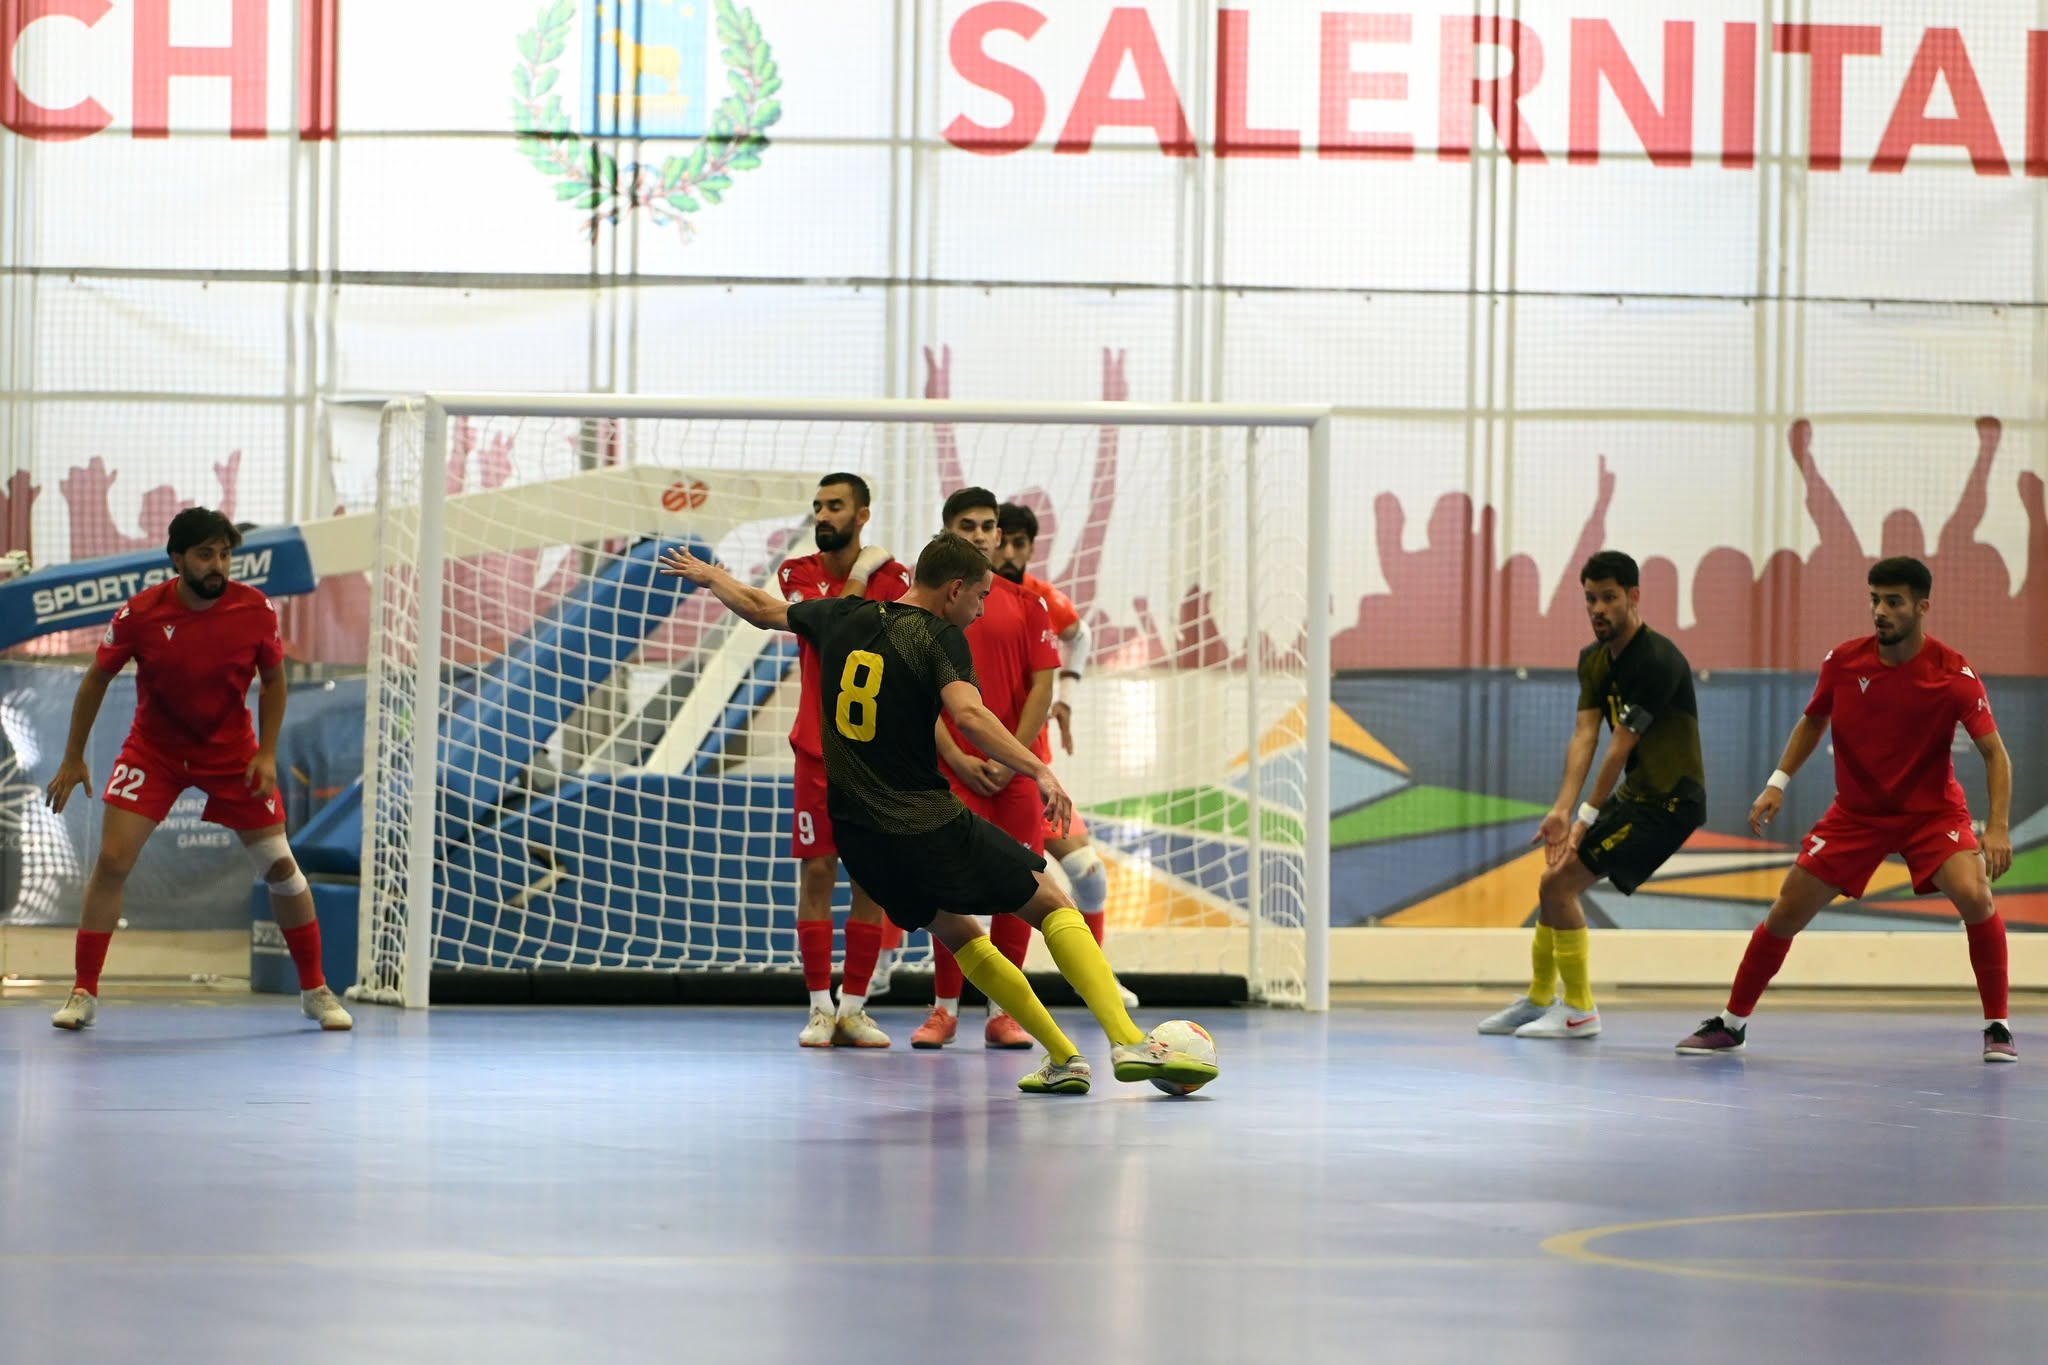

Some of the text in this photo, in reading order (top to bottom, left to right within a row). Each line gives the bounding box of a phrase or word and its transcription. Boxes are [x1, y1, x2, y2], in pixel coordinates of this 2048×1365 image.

[33, 572, 140, 615] SPORT
[836, 650, 884, 742] 8
[107, 763, 146, 802] 22
[798, 811, 816, 846] 9
[1808, 834, 1827, 857] 7
